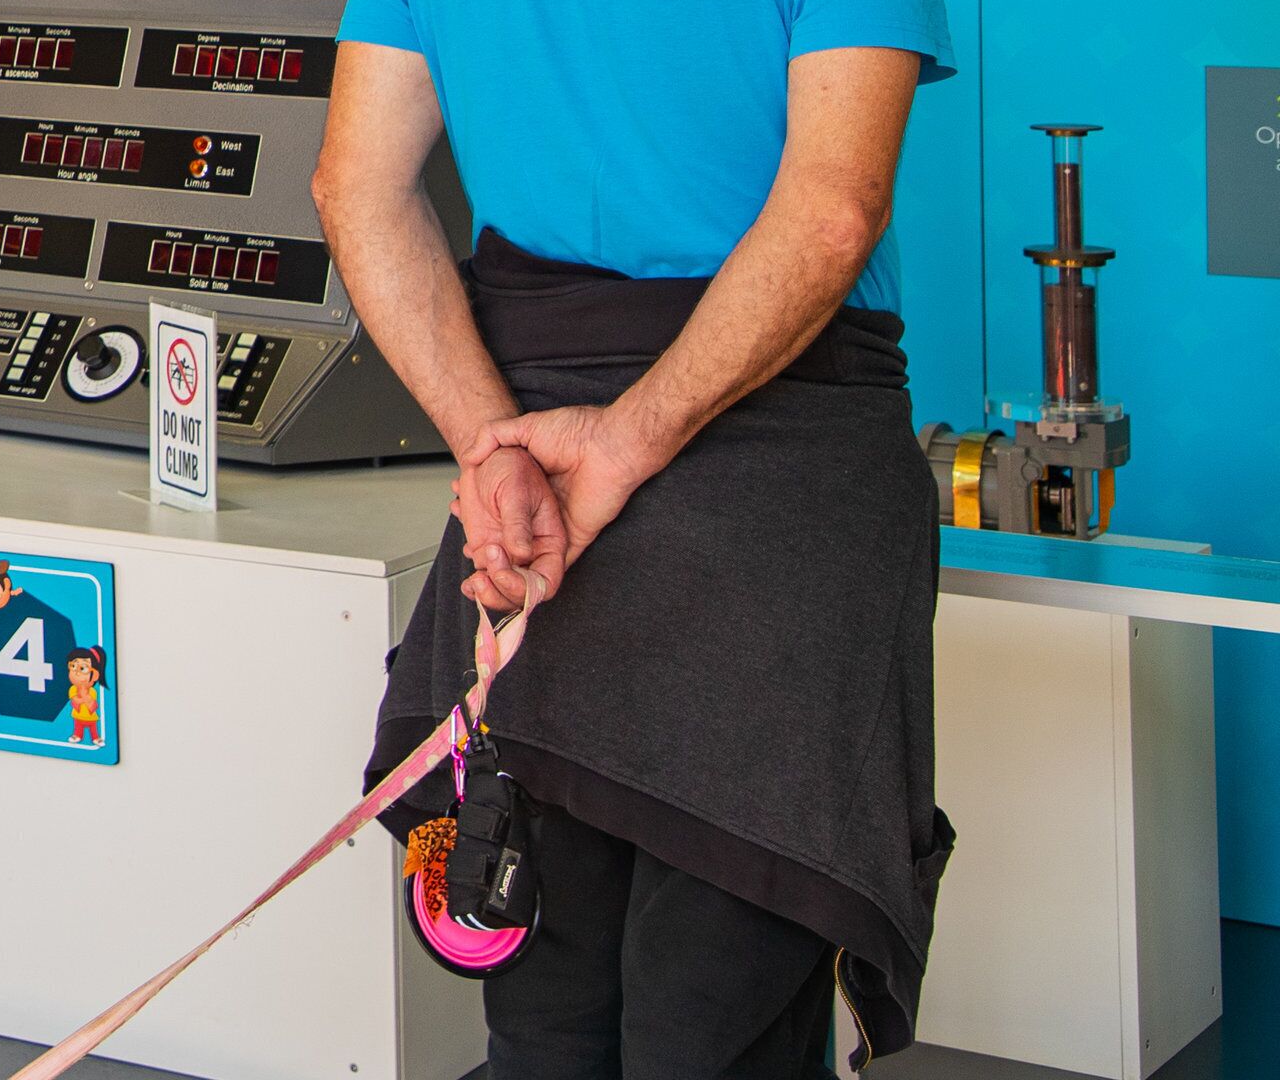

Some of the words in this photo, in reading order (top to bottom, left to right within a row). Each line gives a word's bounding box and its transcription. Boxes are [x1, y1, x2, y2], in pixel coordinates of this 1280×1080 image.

[5, 69, 38, 79] ascension
[212, 81, 254, 93] Declination
[221, 140, 242, 152] West
[58, 170, 75, 179] Hour
[77, 171, 98, 182] angle
[215, 166, 234, 177] East
[184, 178, 210, 189] Limits
[189, 278, 209, 290] Solar
[212, 280, 229, 291] time
[163, 409, 178, 439] DO
[180, 416, 202, 447] NOT
[166, 446, 198, 481] CLIMB
